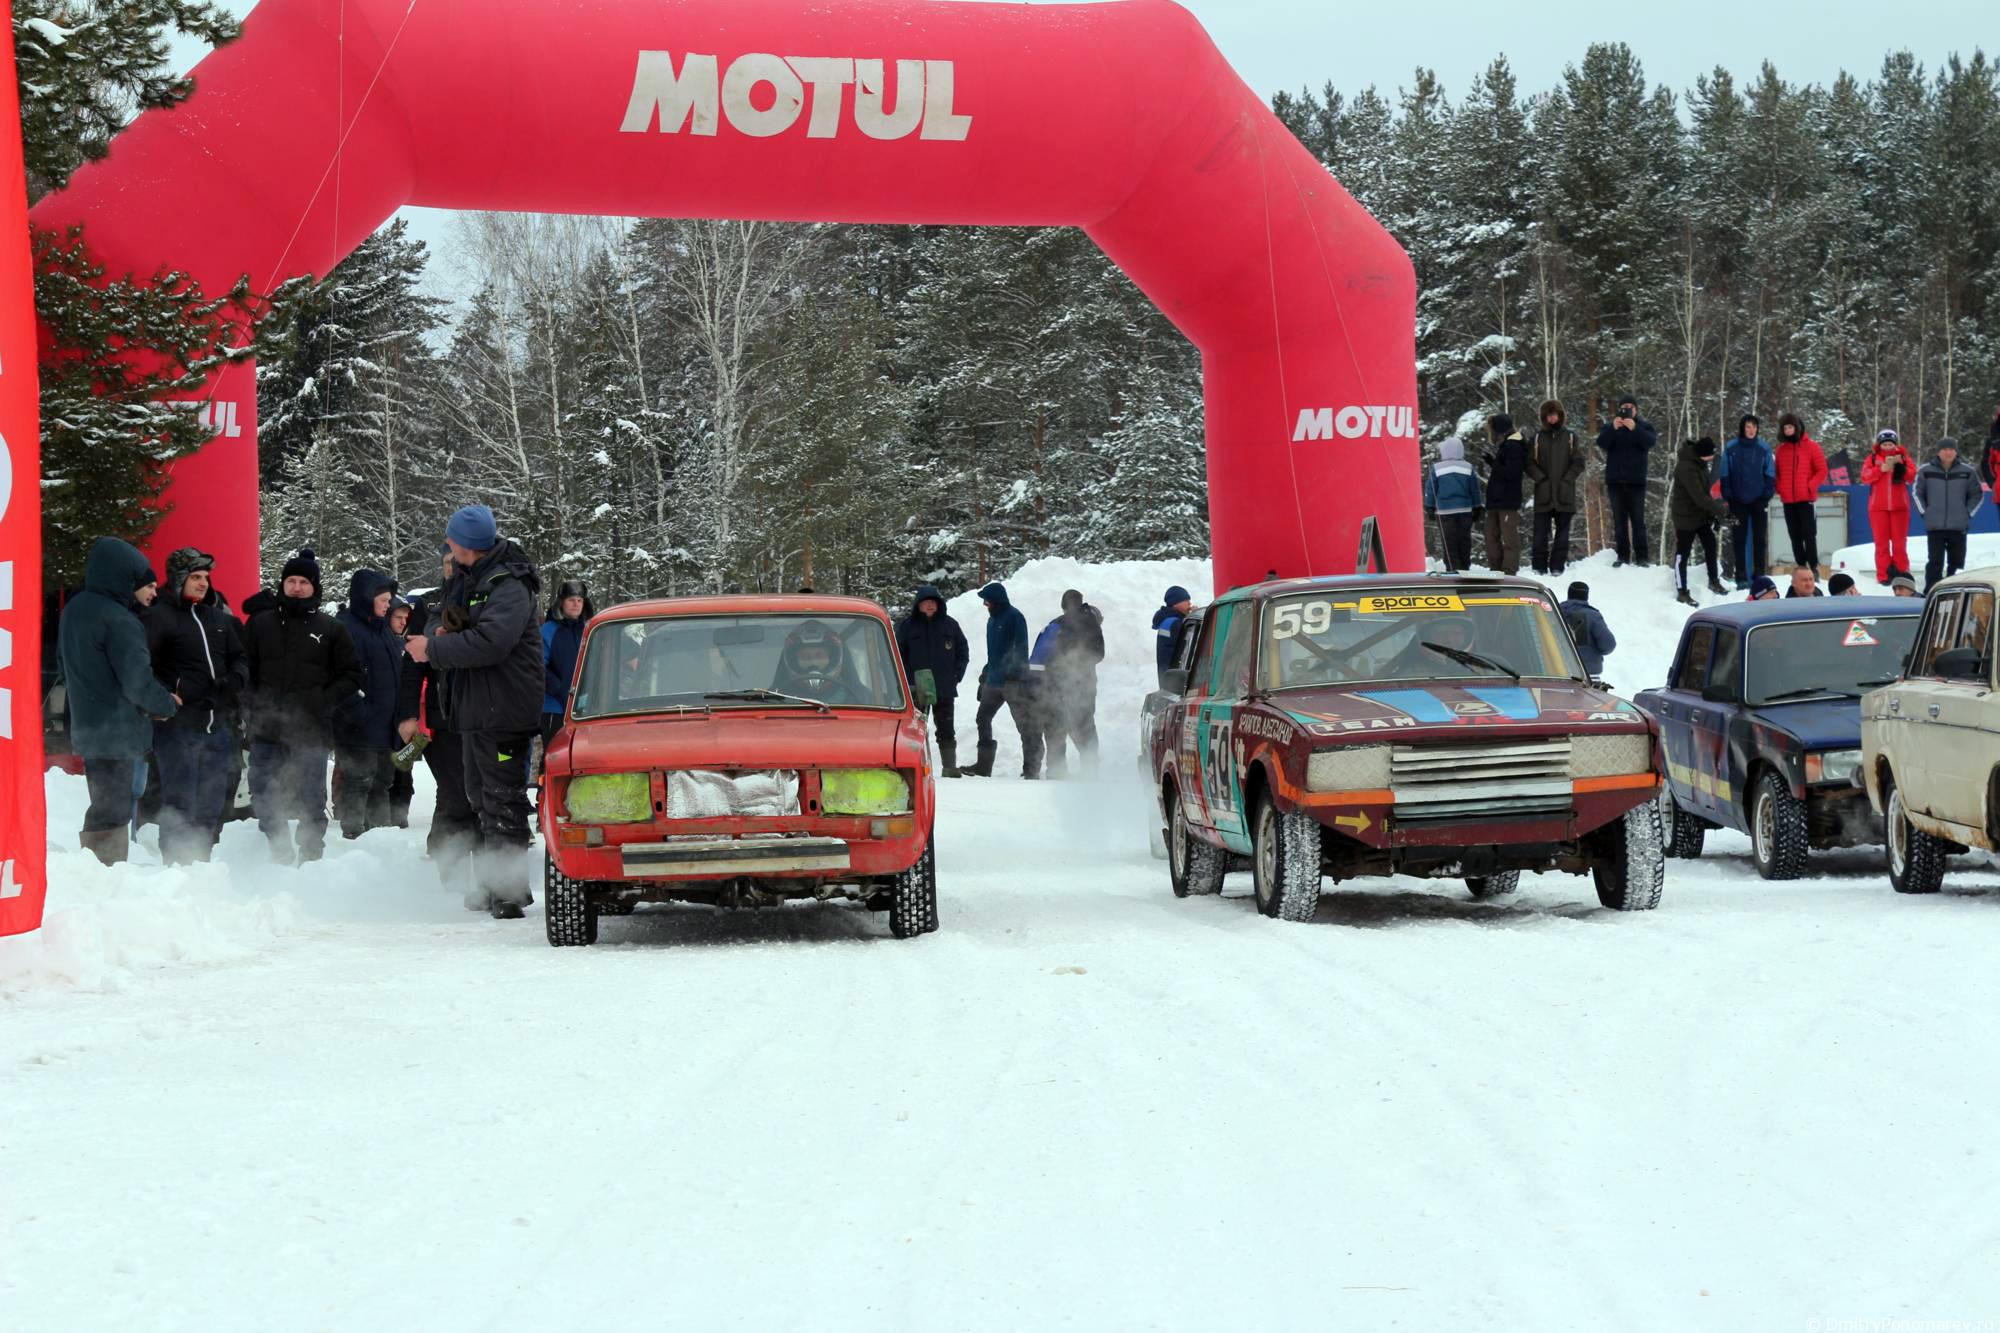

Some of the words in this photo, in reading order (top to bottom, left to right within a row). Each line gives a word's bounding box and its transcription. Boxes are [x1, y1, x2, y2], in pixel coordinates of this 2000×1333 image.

[619, 49, 973, 141] MOTUL
[1292, 405, 1415, 442] MOTUL
[1272, 600, 1332, 640] 59
[1371, 595, 1451, 611] sparco
[1316, 717, 1416, 732] TEAM
[1207, 725, 1232, 811] 59
